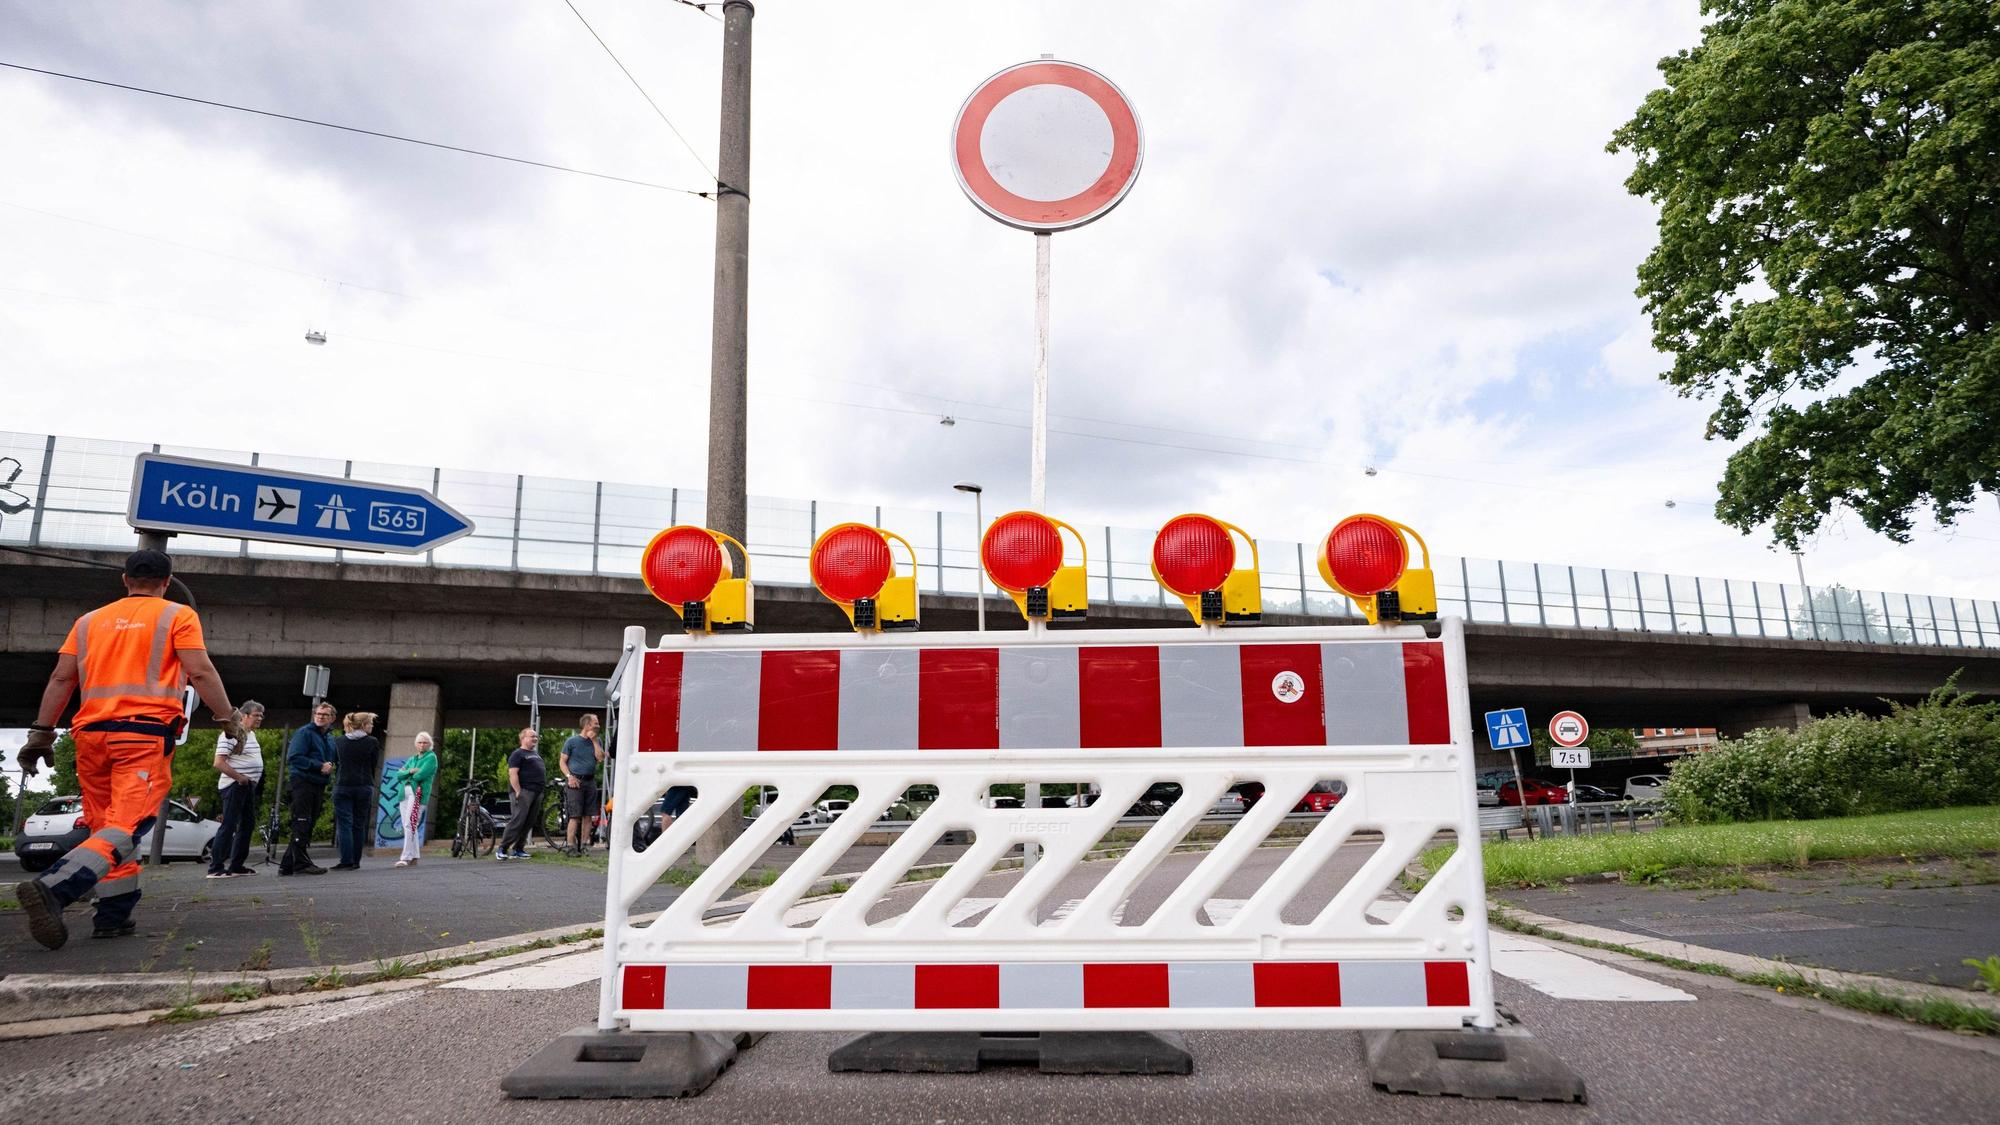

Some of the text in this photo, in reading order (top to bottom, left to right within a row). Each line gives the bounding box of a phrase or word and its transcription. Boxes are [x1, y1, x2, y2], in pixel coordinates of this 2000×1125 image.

[160, 480, 240, 513] Köln
[377, 508, 418, 530] 565
[1008, 822, 1071, 833] nissen
